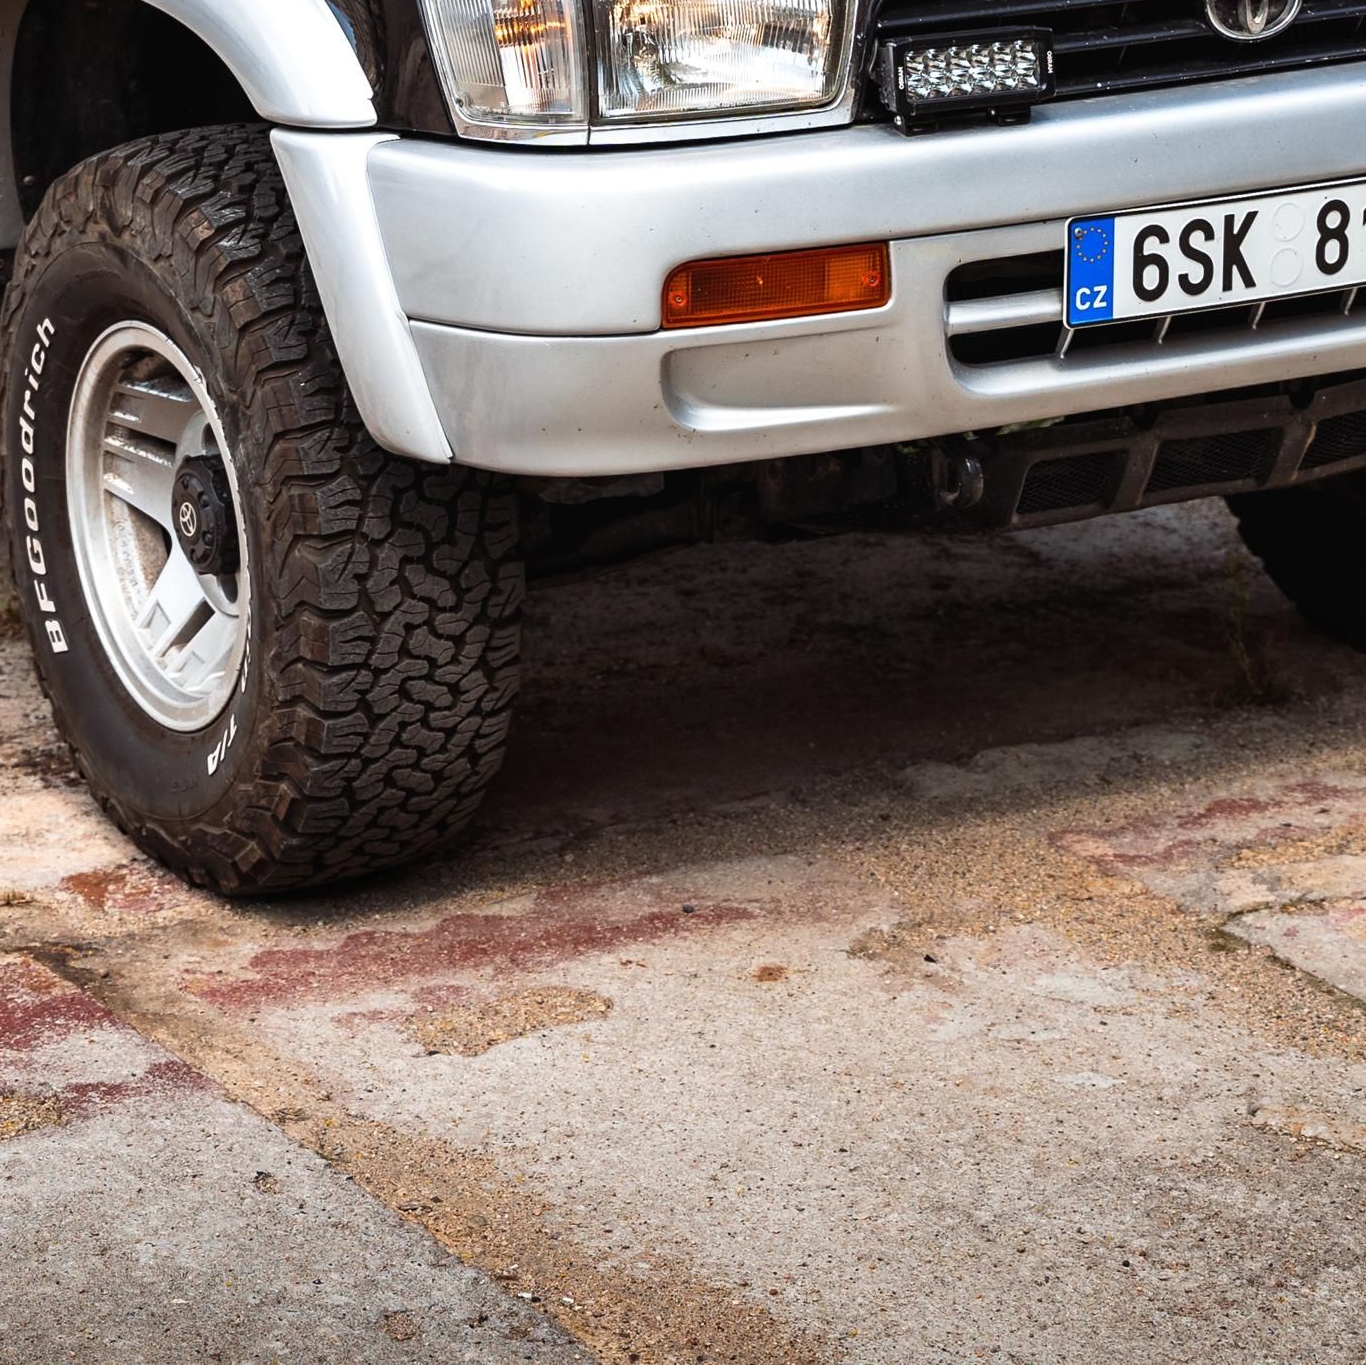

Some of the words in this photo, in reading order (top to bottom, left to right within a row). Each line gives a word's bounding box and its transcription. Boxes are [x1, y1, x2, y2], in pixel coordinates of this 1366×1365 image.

[1075, 285, 1107, 311] CZ
[1133, 210, 1259, 302] 6SK
[20, 318, 69, 653] BFGoodrich
